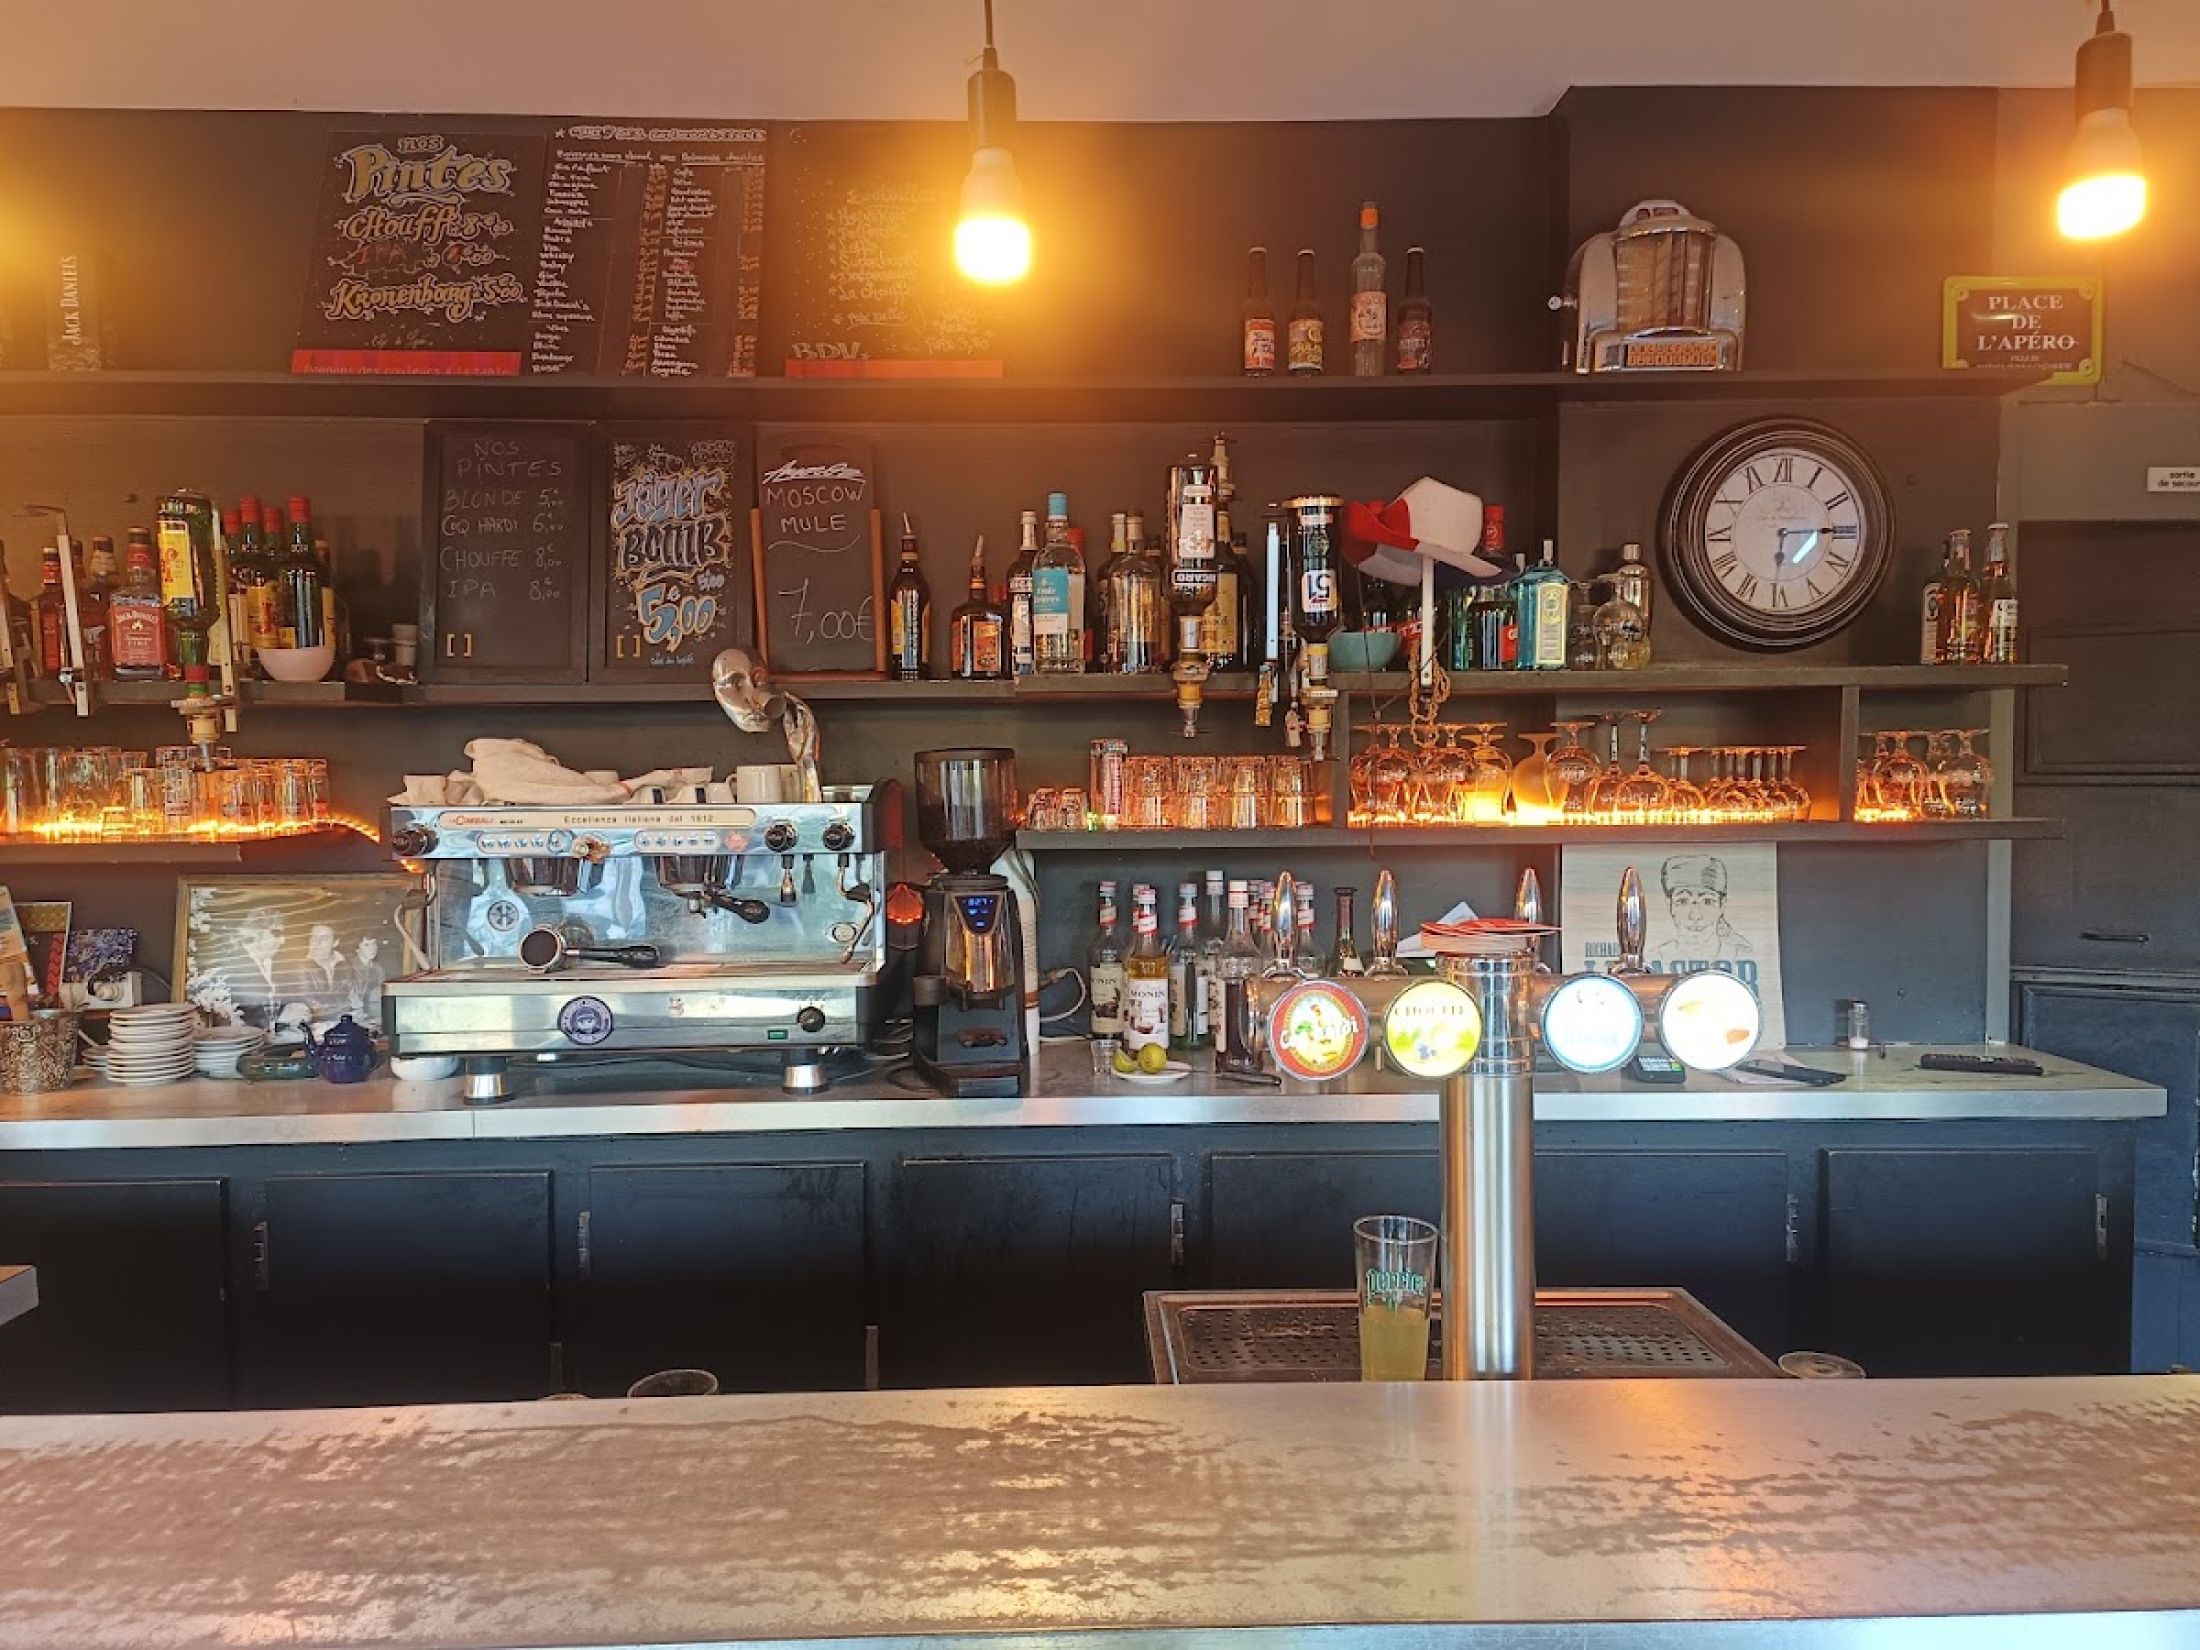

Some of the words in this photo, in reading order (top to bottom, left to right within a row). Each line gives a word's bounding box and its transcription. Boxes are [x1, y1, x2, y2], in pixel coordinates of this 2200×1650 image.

[348, 144, 513, 202] Pintes
[1988, 294, 2064, 311] PLACE
[2011, 314, 2042, 329] DE
[1977, 332, 2076, 351] L'APÉRO
[474, 440, 520, 457] NOS
[2169, 471, 2195, 479] sortie
[443, 488, 522, 512] BLONDE
[766, 481, 866, 508] MOSCOW
[780, 514, 846, 534] MULE
[440, 545, 523, 572] CHOUFFE
[448, 579, 496, 598] IPA
[1308, 574, 1331, 601] 51
[778, 578, 873, 645] 7,00€
[1130, 989, 1165, 998] MONIN
